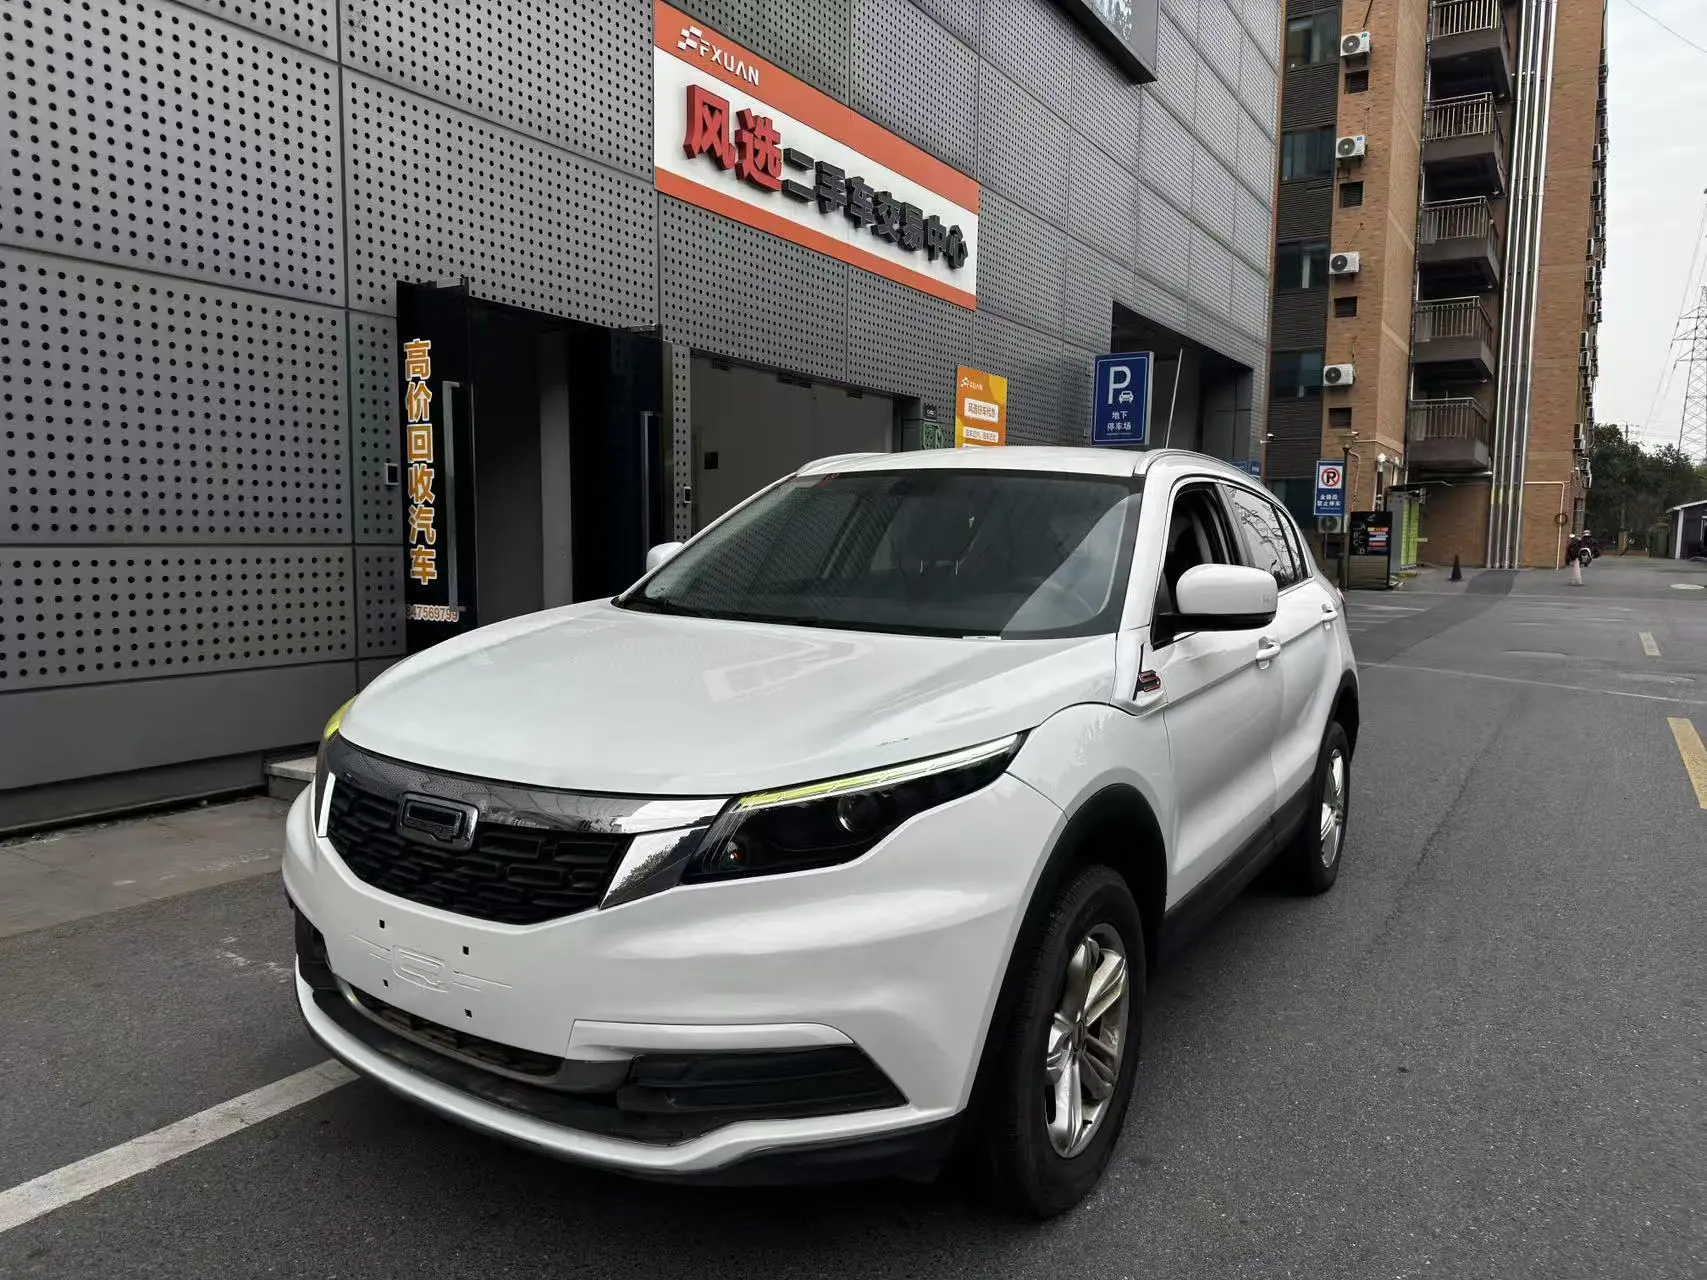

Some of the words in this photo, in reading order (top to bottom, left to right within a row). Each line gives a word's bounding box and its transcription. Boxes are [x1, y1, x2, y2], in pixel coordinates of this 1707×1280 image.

[699, 39, 759, 86] FXUAN
[1107, 421, 1131, 431] 停车场
[1112, 410, 1128, 420] 地下
[403, 338, 437, 585] 高价回收汽车
